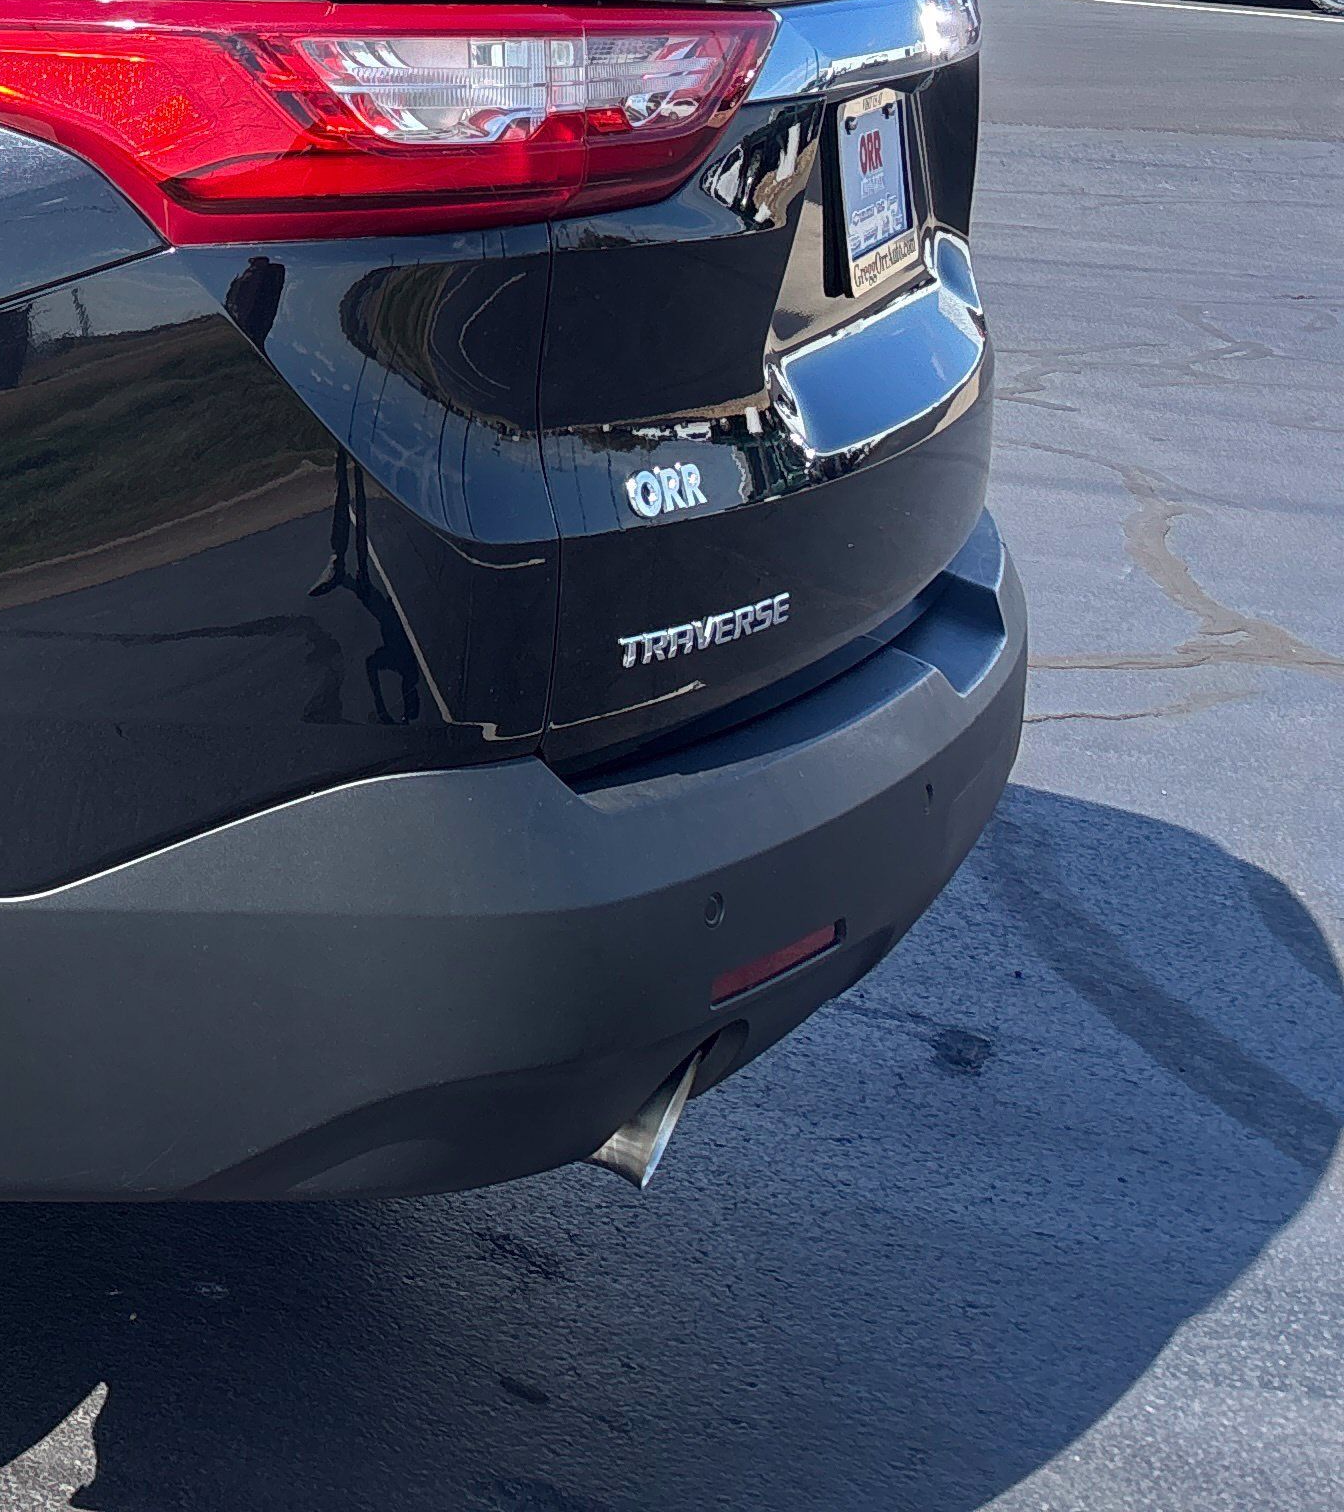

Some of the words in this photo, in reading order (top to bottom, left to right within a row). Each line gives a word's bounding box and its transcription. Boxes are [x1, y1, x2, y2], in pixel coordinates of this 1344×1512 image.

[858, 129, 884, 176] ORR
[626, 463, 708, 518] ORR
[618, 591, 791, 669] TRAVERSE
